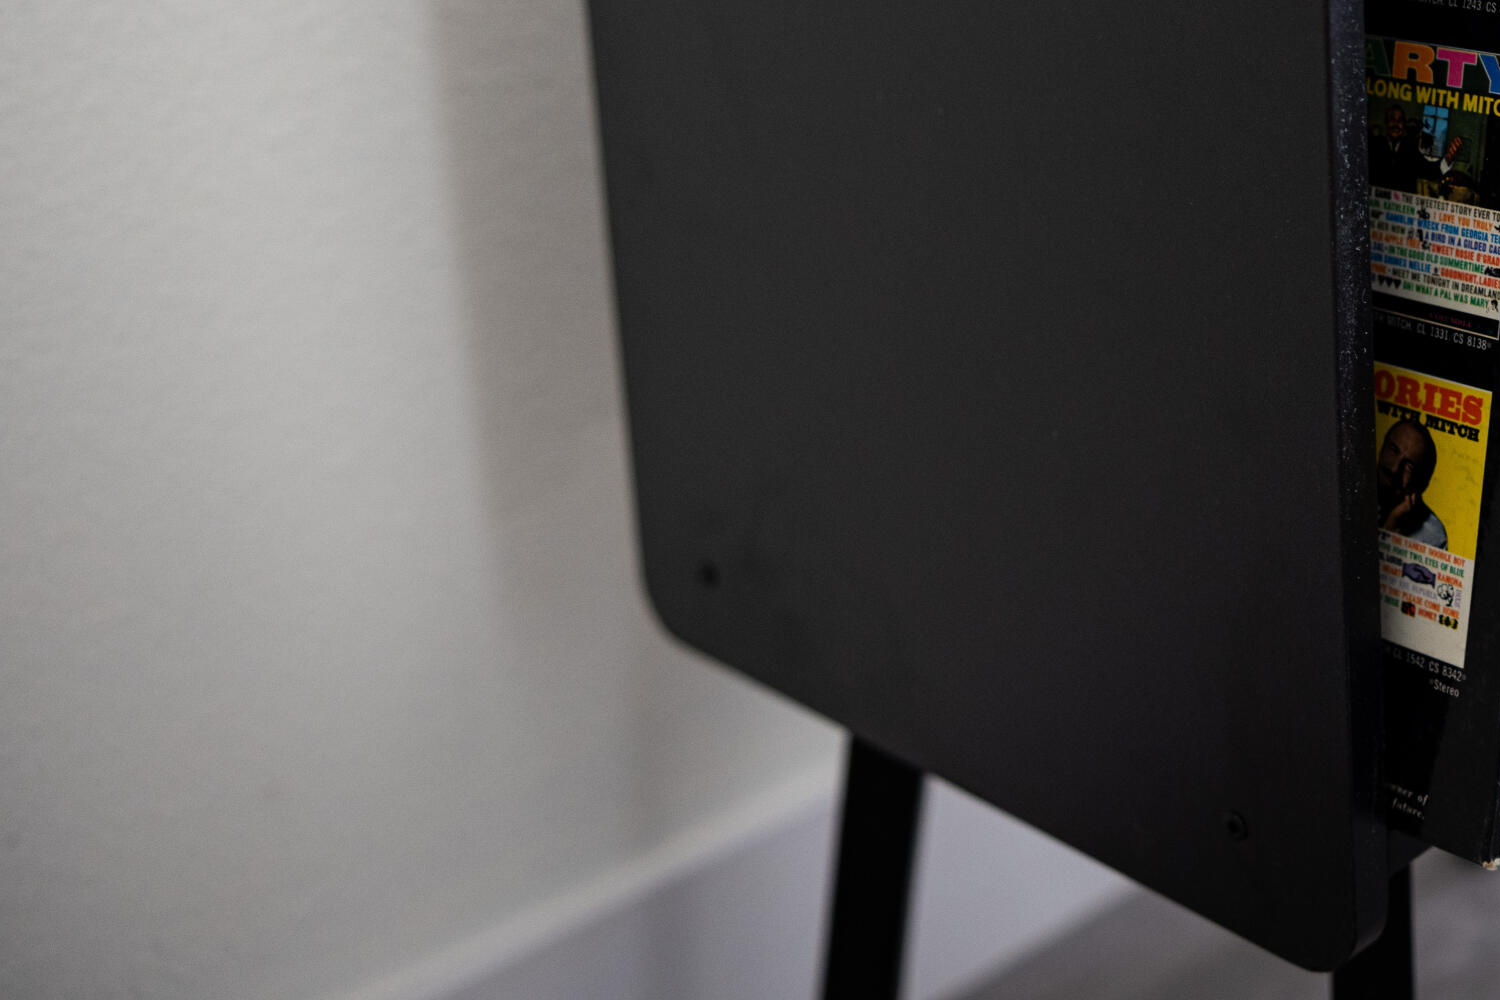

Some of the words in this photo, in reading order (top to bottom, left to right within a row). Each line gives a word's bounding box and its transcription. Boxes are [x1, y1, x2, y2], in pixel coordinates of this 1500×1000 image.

[1485, 0, 1497, 13] CS
[1366, 77, 1412, 102] LONG
[1415, 85, 1459, 110] WITH
[1450, 203, 1471, 216] STORY
[1473, 207, 1490, 220] EVER
[1416, 218, 1439, 231] WRECK
[1441, 223, 1458, 235] FROM
[1461, 227, 1489, 241] GEORGIA
[1457, 215, 1470, 227] YOU
[1472, 218, 1493, 231] TRULY
[1431, 231, 1446, 243] BIRD
[1448, 235, 1455, 245] IN
[1463, 238, 1486, 252] GILDED
[1431, 242, 1453, 256] SWEET
[1454, 247, 1474, 260] ROSIE
[1439, 255, 1484, 274] SUMMERTIME
[1439, 288, 1451, 300] PAL
[1453, 292, 1468, 304] WAS
[1469, 295, 1489, 309] MARY
[1451, 280, 1458, 290] IN
[1460, 282, 1500, 300] DREAMLAND
[1430, 326, 1449, 341] 1331
[1453, 332, 1464, 345] CS
[1374, 369, 1484, 426] ORIES
[1377, 400, 1422, 424] WITH
[1426, 414, 1480, 442] MITCH
[1424, 556, 1438, 569] EYES
[1440, 561, 1448, 572] OF
[1449, 564, 1465, 578] BLUE
